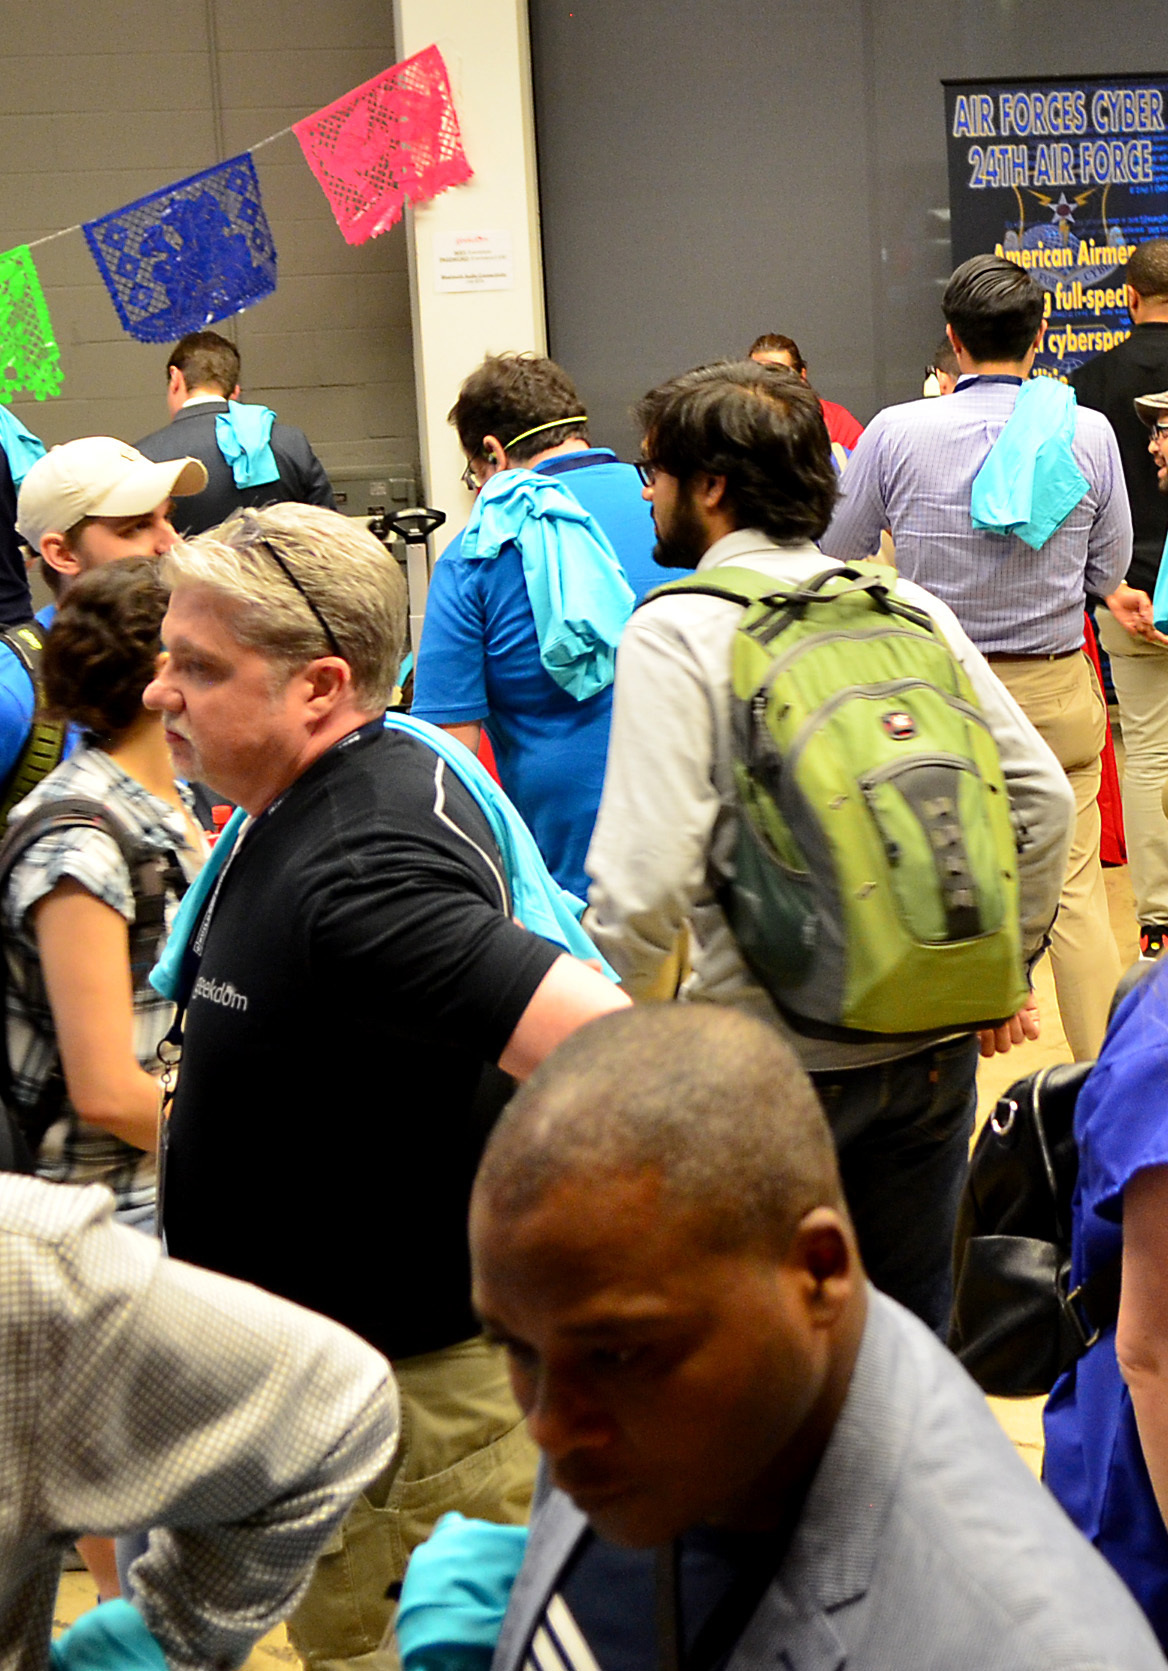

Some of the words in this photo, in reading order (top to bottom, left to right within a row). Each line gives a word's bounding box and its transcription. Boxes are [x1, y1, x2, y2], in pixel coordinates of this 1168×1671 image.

[953, 95, 996, 137] AIR
[1000, 91, 1087, 136] FORCES
[1092, 89, 1165, 133] CYBER
[968, 144, 1028, 188] 24TH
[1034, 143, 1076, 185] AIR
[1080, 141, 1152, 184] FORCE
[995, 241, 1073, 268] American
